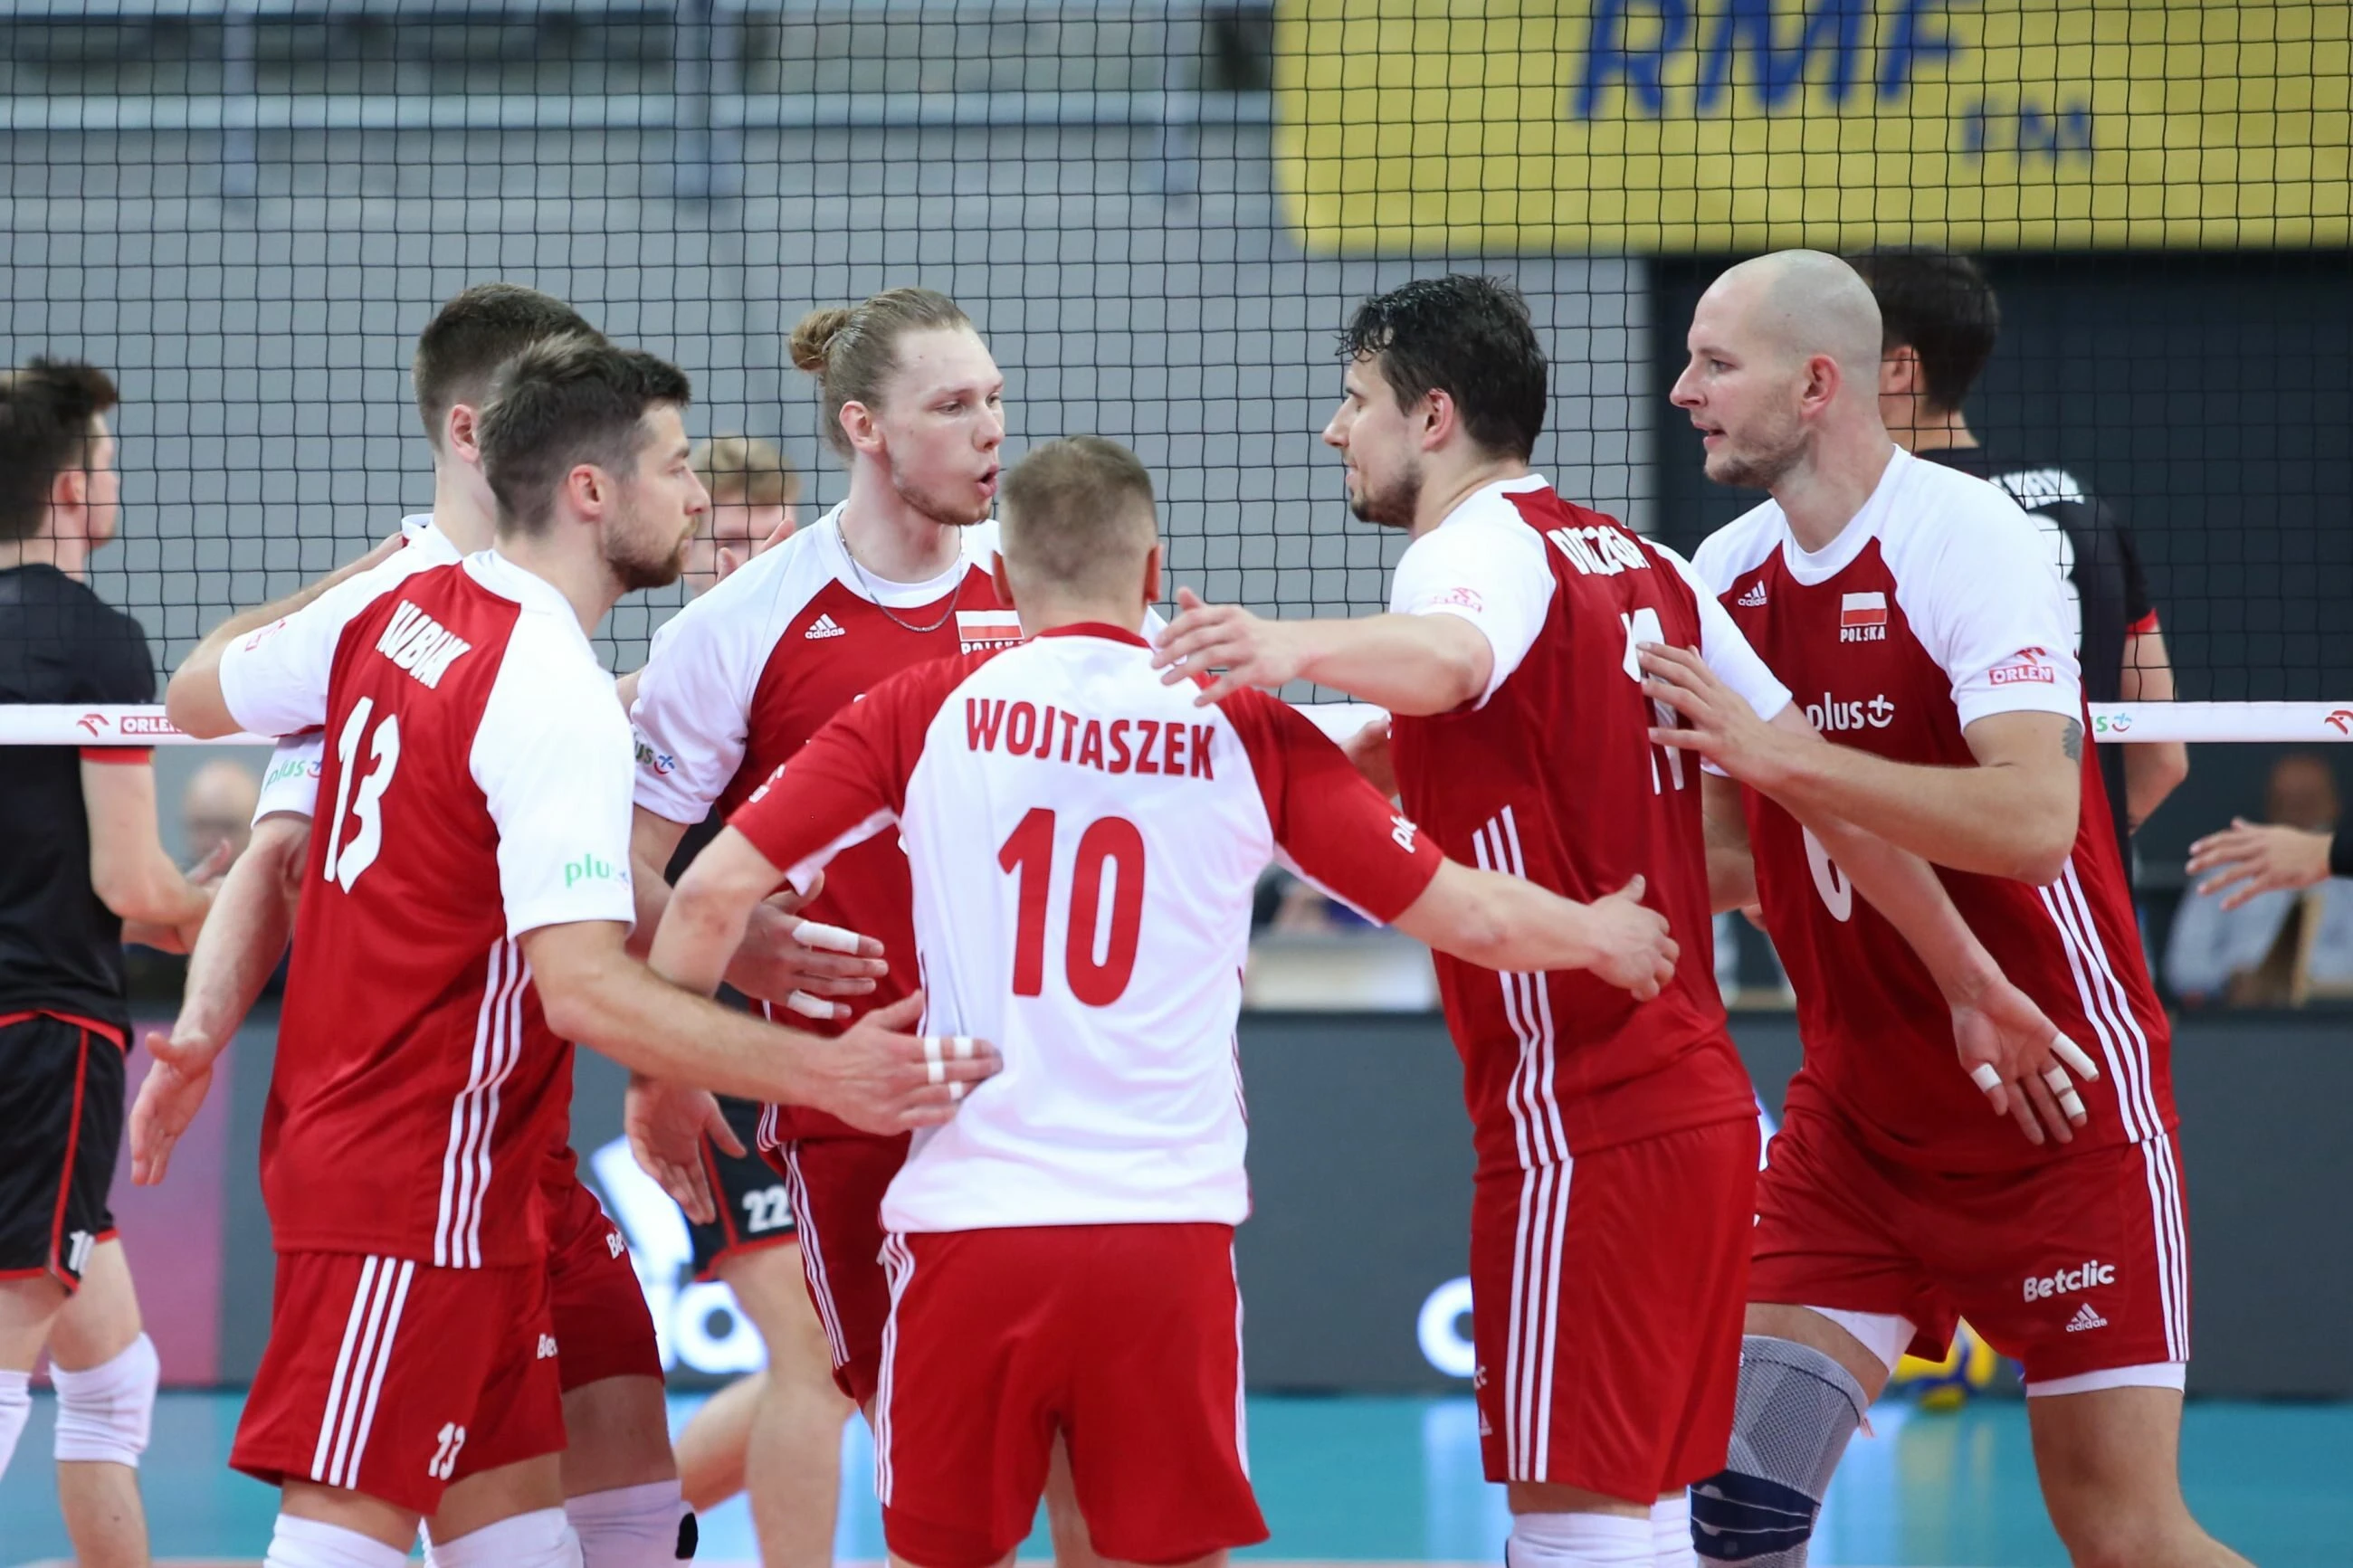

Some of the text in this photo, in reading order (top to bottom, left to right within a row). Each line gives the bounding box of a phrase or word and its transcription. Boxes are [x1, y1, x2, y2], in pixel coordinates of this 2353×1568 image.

[1572, 0, 1968, 122] RMF
[375, 599, 472, 689] KUBIAK
[805, 627, 845, 640] adidas
[1840, 626, 1885, 642] POLSKA
[1993, 667, 2052, 683] ORLEN
[966, 698, 1215, 781] WOJTASZEK
[323, 696, 401, 895] 13
[565, 853, 619, 888] plu
[998, 807, 1145, 1008] 10
[742, 1184, 795, 1233] 22
[2023, 1259, 2115, 1303] Betclic
[2065, 1317, 2108, 1333] adidas
[427, 1421, 466, 1481] 13
